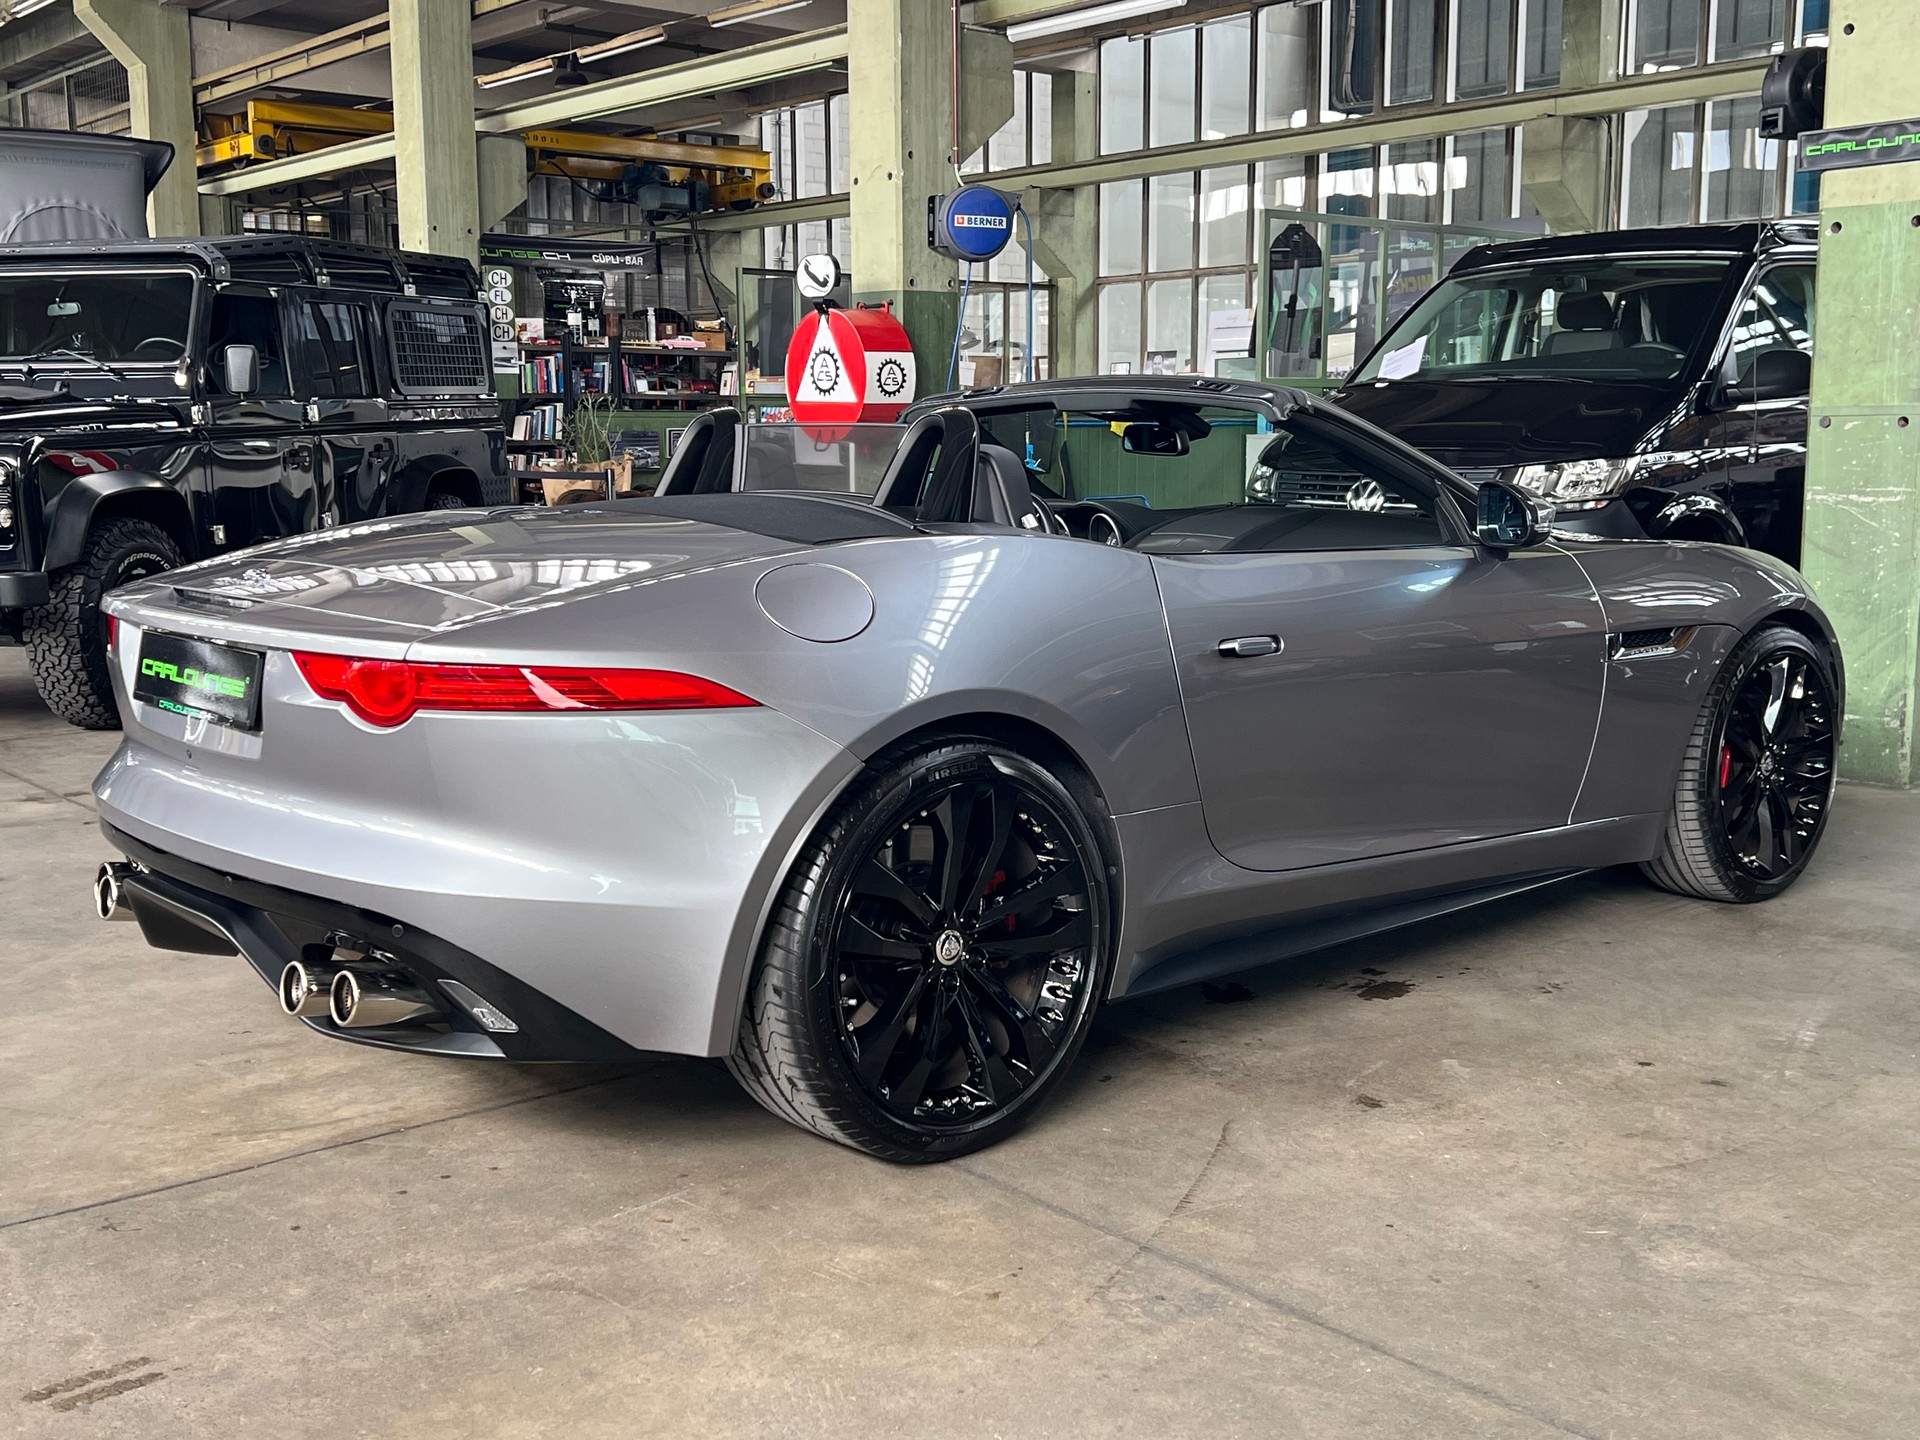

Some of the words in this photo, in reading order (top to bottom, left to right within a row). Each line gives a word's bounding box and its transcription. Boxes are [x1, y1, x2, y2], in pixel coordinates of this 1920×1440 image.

[967, 216, 1004, 227] BERNER
[491, 271, 507, 285] CH
[494, 290, 507, 302] FL
[494, 307, 508, 320] CH
[493, 325, 510, 339] CH
[118, 552, 172, 574] BFGoodric
[141, 658, 246, 698] CARLOUNGE
